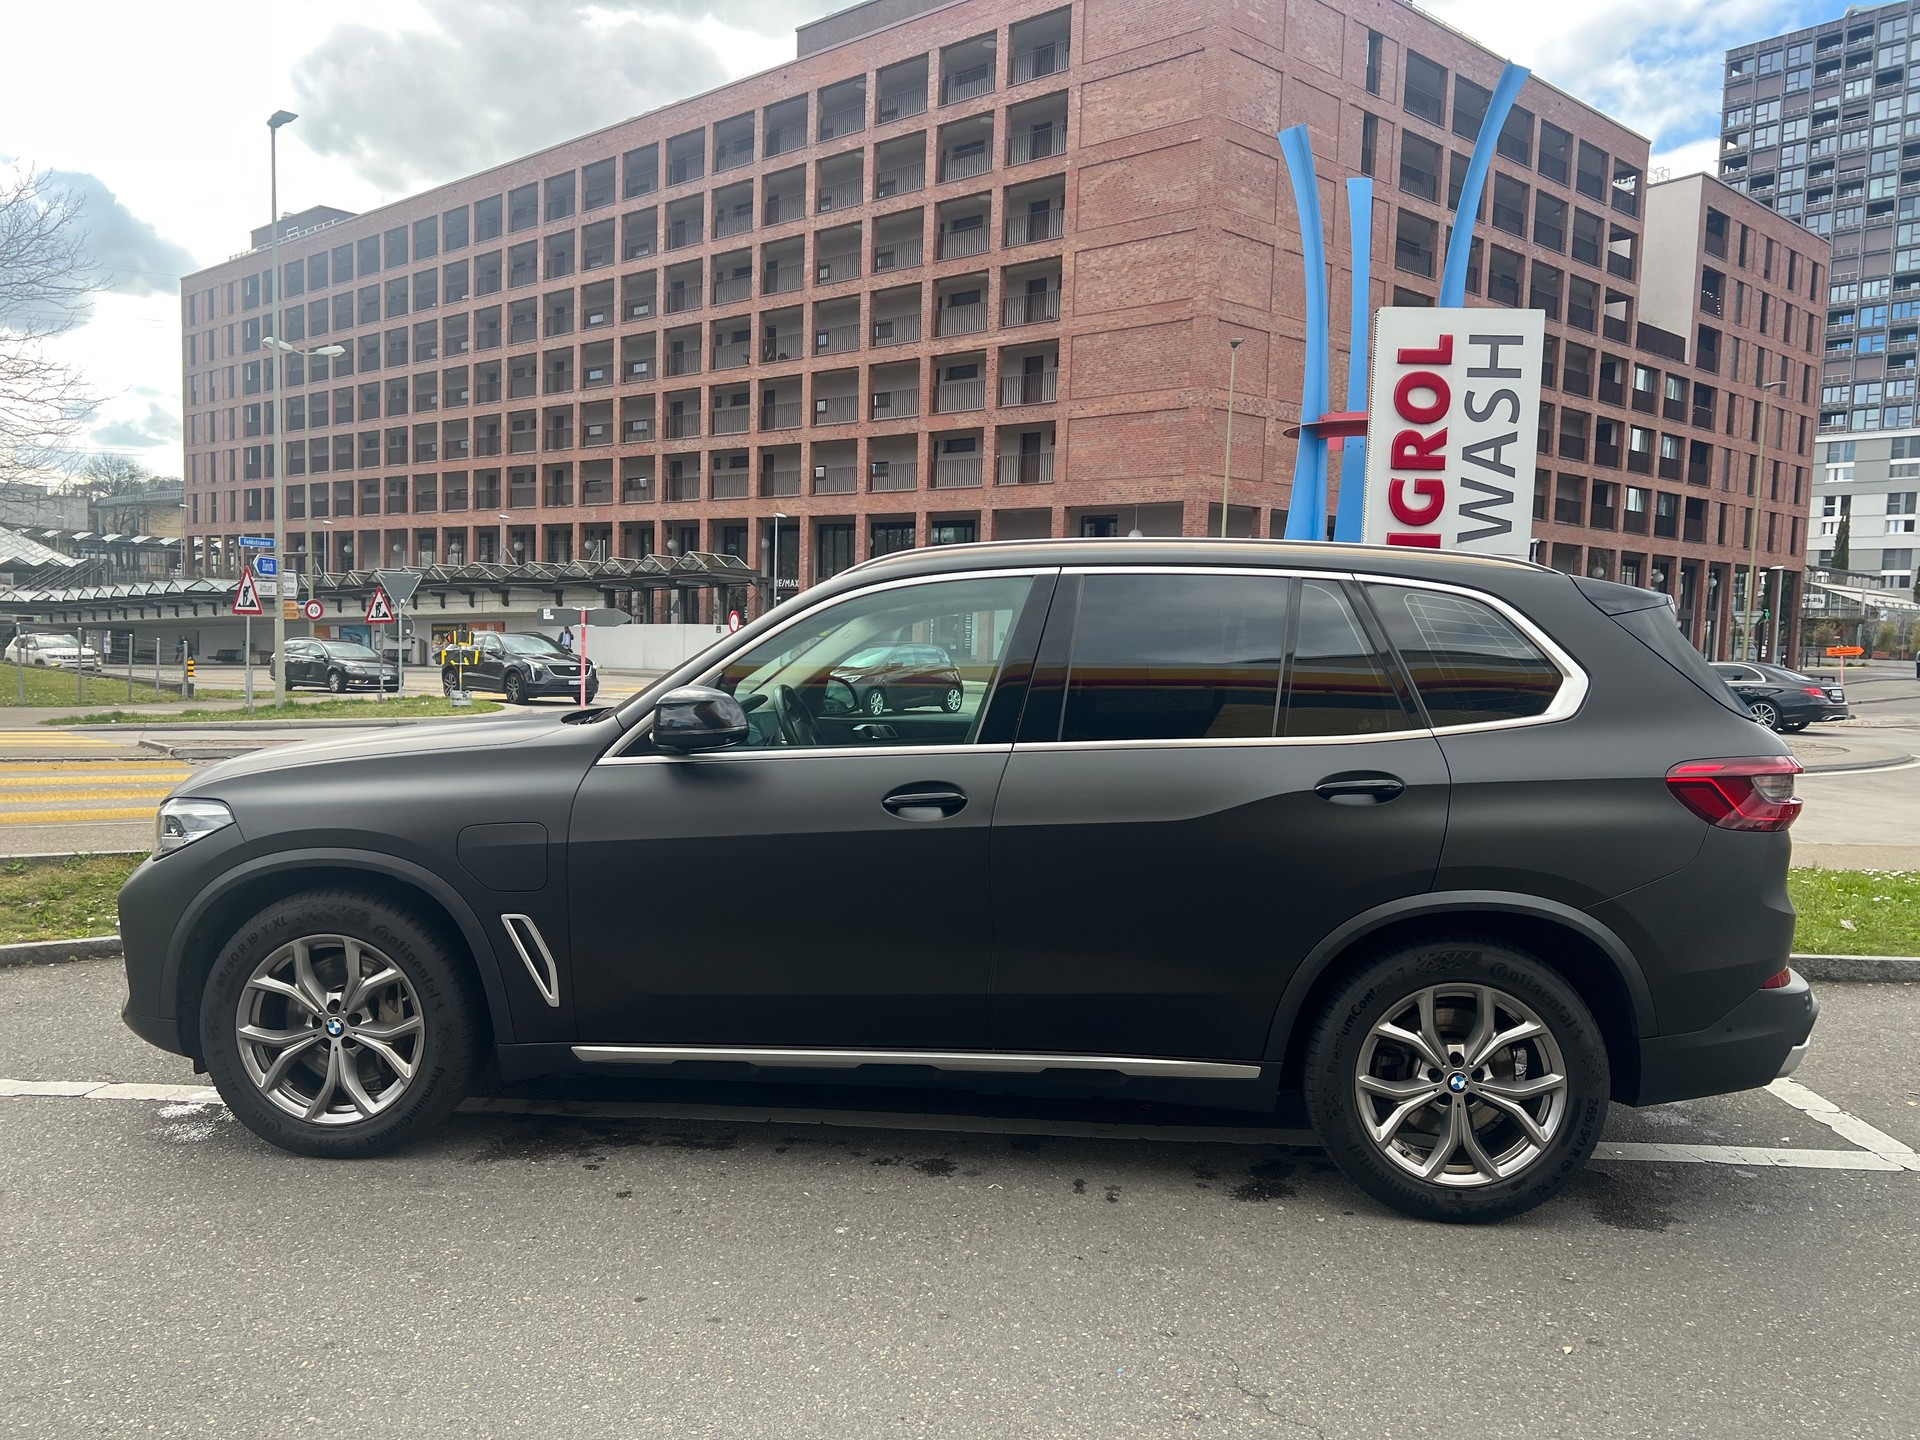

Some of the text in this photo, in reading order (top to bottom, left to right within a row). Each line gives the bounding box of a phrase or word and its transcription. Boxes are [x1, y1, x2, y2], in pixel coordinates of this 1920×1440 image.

[1456, 334, 1524, 544] WASH
[243, 539, 271, 547] Feldstrasse
[310, 606, 319, 615] 60
[246, 932, 258, 946] 19
[272, 916, 288, 929] XL
[372, 925, 442, 999] Continental
[1489, 961, 1578, 1029] Continental
[365, 1065, 445, 1146] PremiumContact
[1576, 1098, 1599, 1147] 265/50
